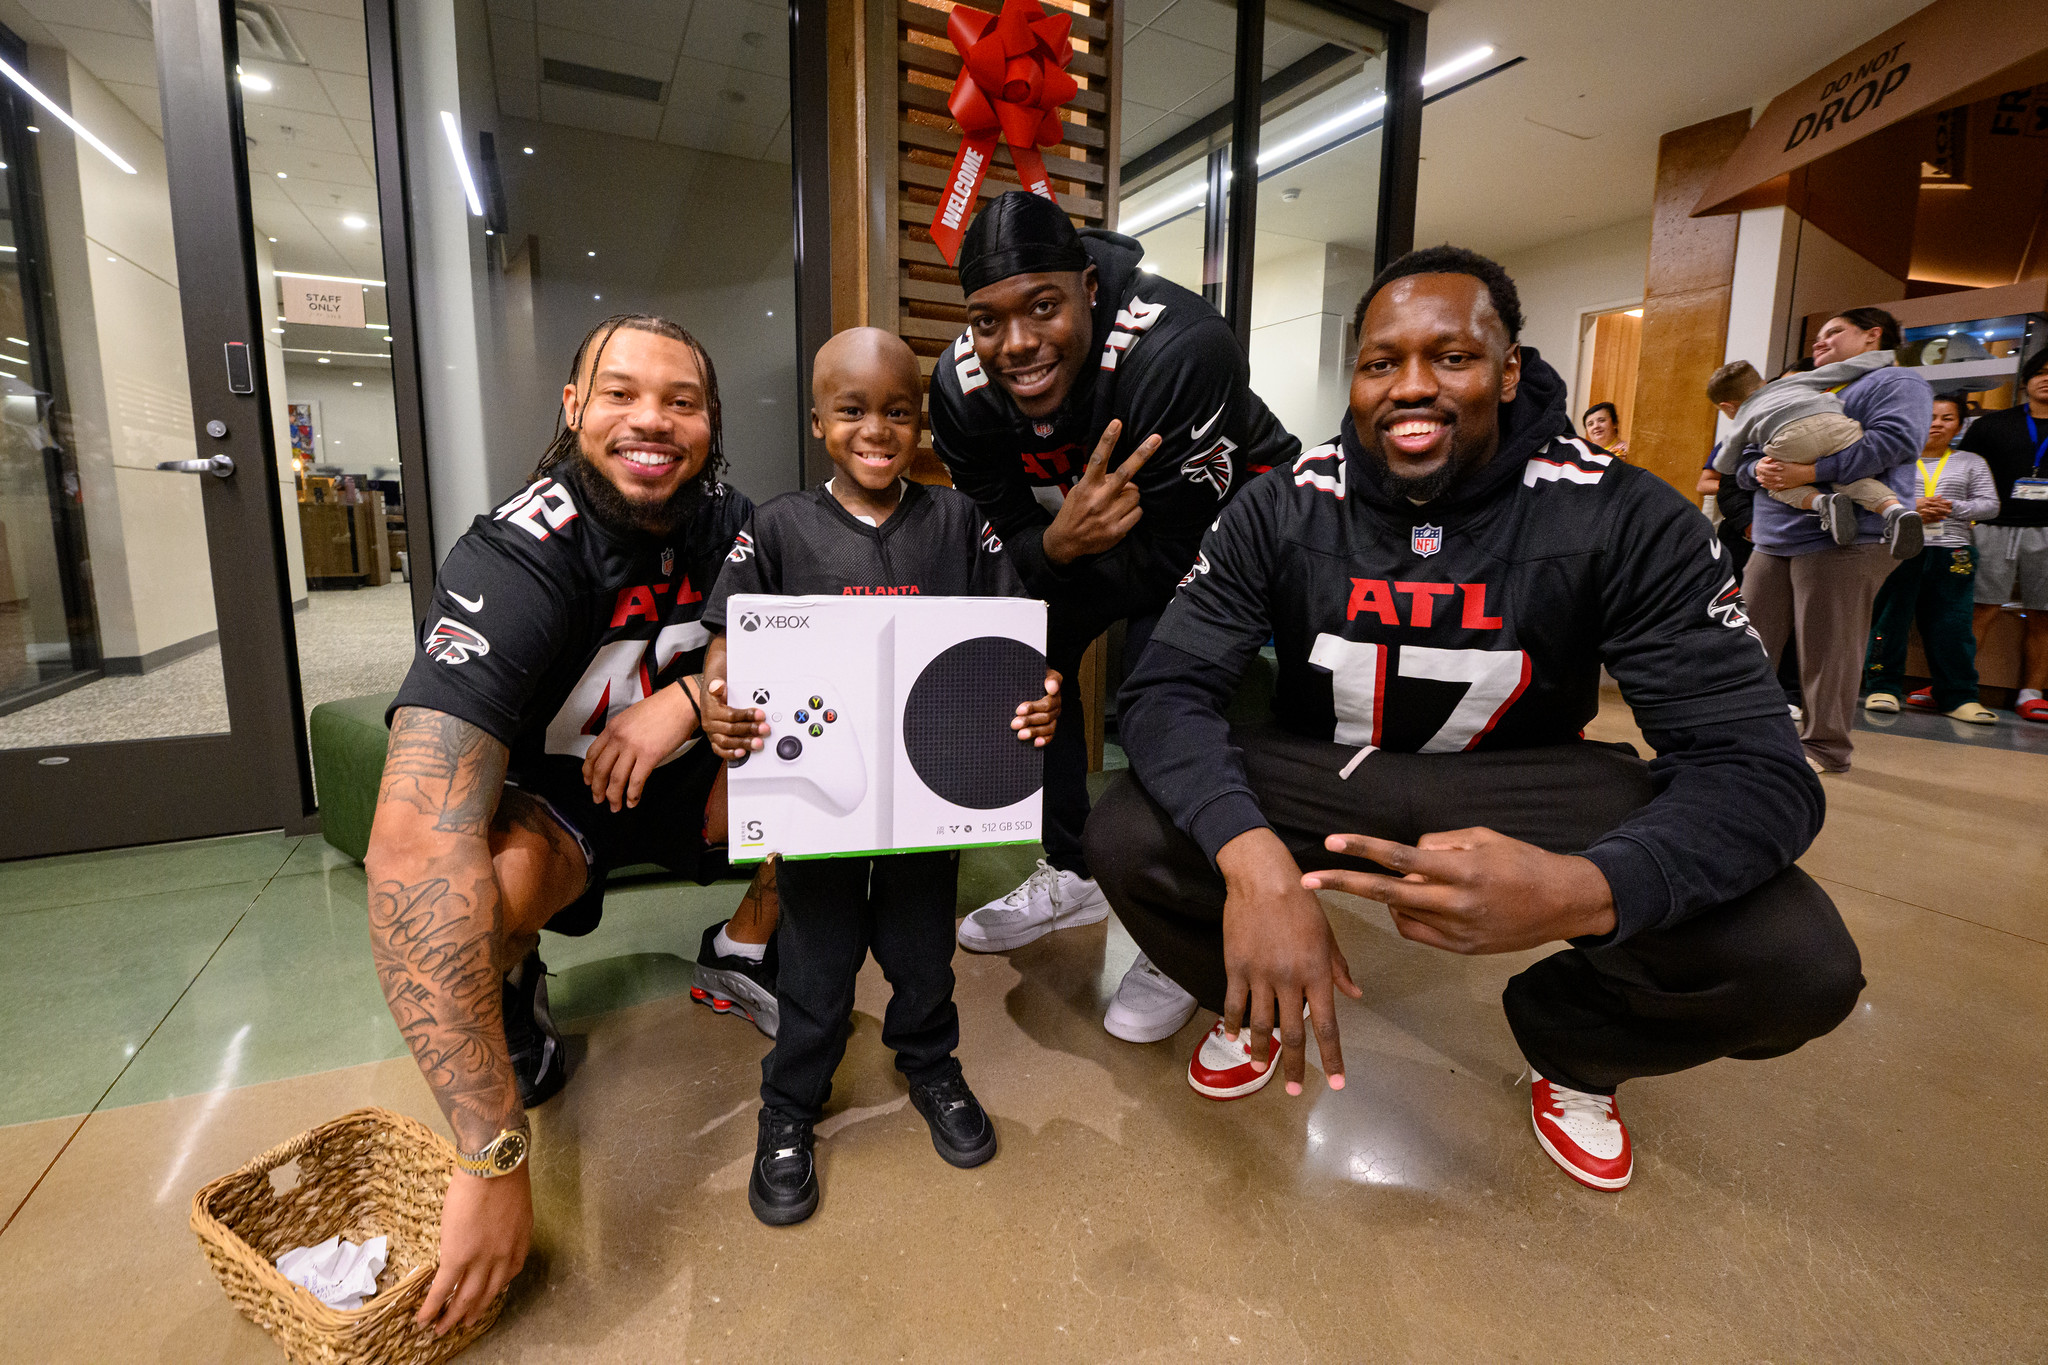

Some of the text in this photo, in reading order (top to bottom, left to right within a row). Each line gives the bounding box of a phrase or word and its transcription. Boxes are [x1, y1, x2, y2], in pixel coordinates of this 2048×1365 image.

[1820, 41, 1906, 101] DO NOT
[1783, 62, 1911, 153] DROP
[940, 146, 984, 231] WELCOME
[305, 293, 342, 303] STAFF
[308, 302, 341, 312] ONLY
[842, 585, 921, 596] ATLANTA
[1346, 577, 1503, 630] ATL
[764, 615, 810, 629] XBOX
[1307, 632, 1532, 754] 17
[746, 820, 764, 841] S
[981, 820, 1033, 833] 512 GB SSD
